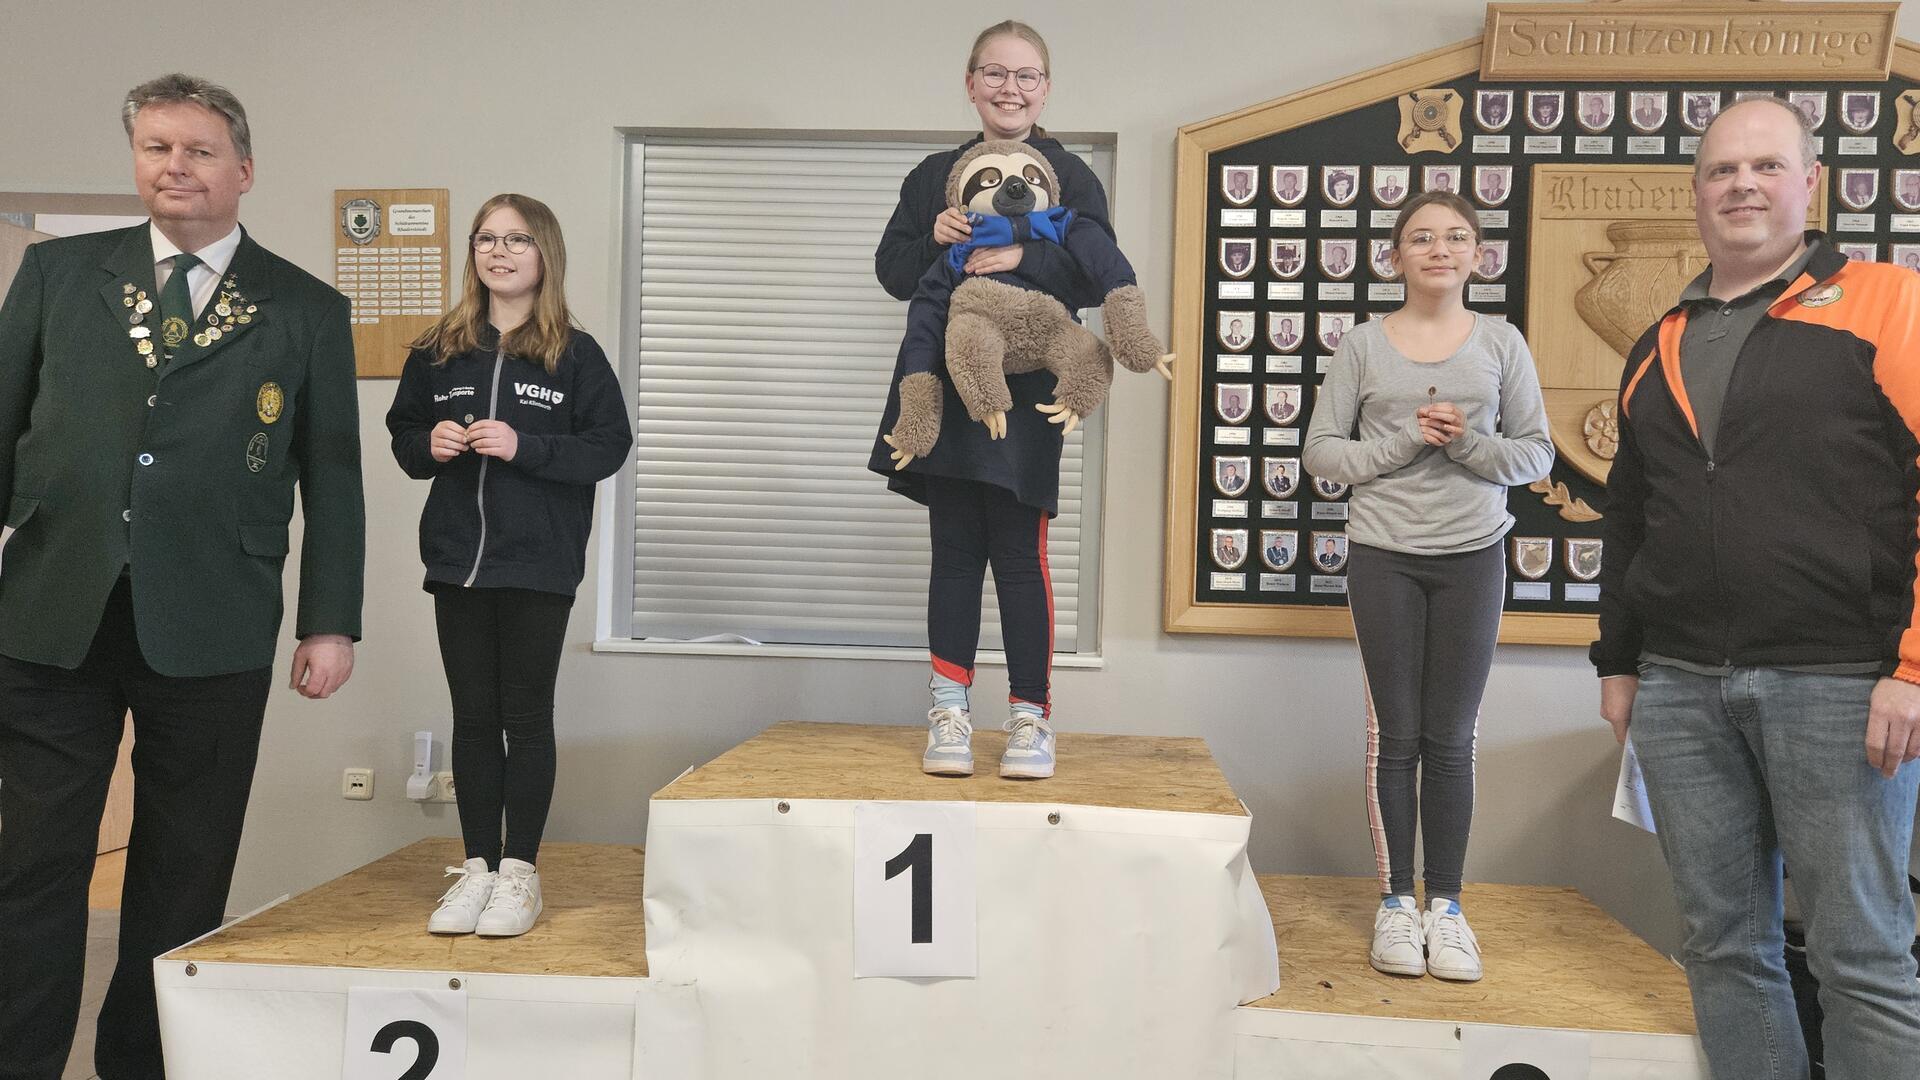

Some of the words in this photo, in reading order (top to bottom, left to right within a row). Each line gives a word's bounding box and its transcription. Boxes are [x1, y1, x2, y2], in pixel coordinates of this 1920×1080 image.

[1506, 17, 1873, 68] Schützenkönige
[514, 382, 552, 401] VGH
[885, 834, 933, 943] 1
[370, 1020, 440, 1080] 2
